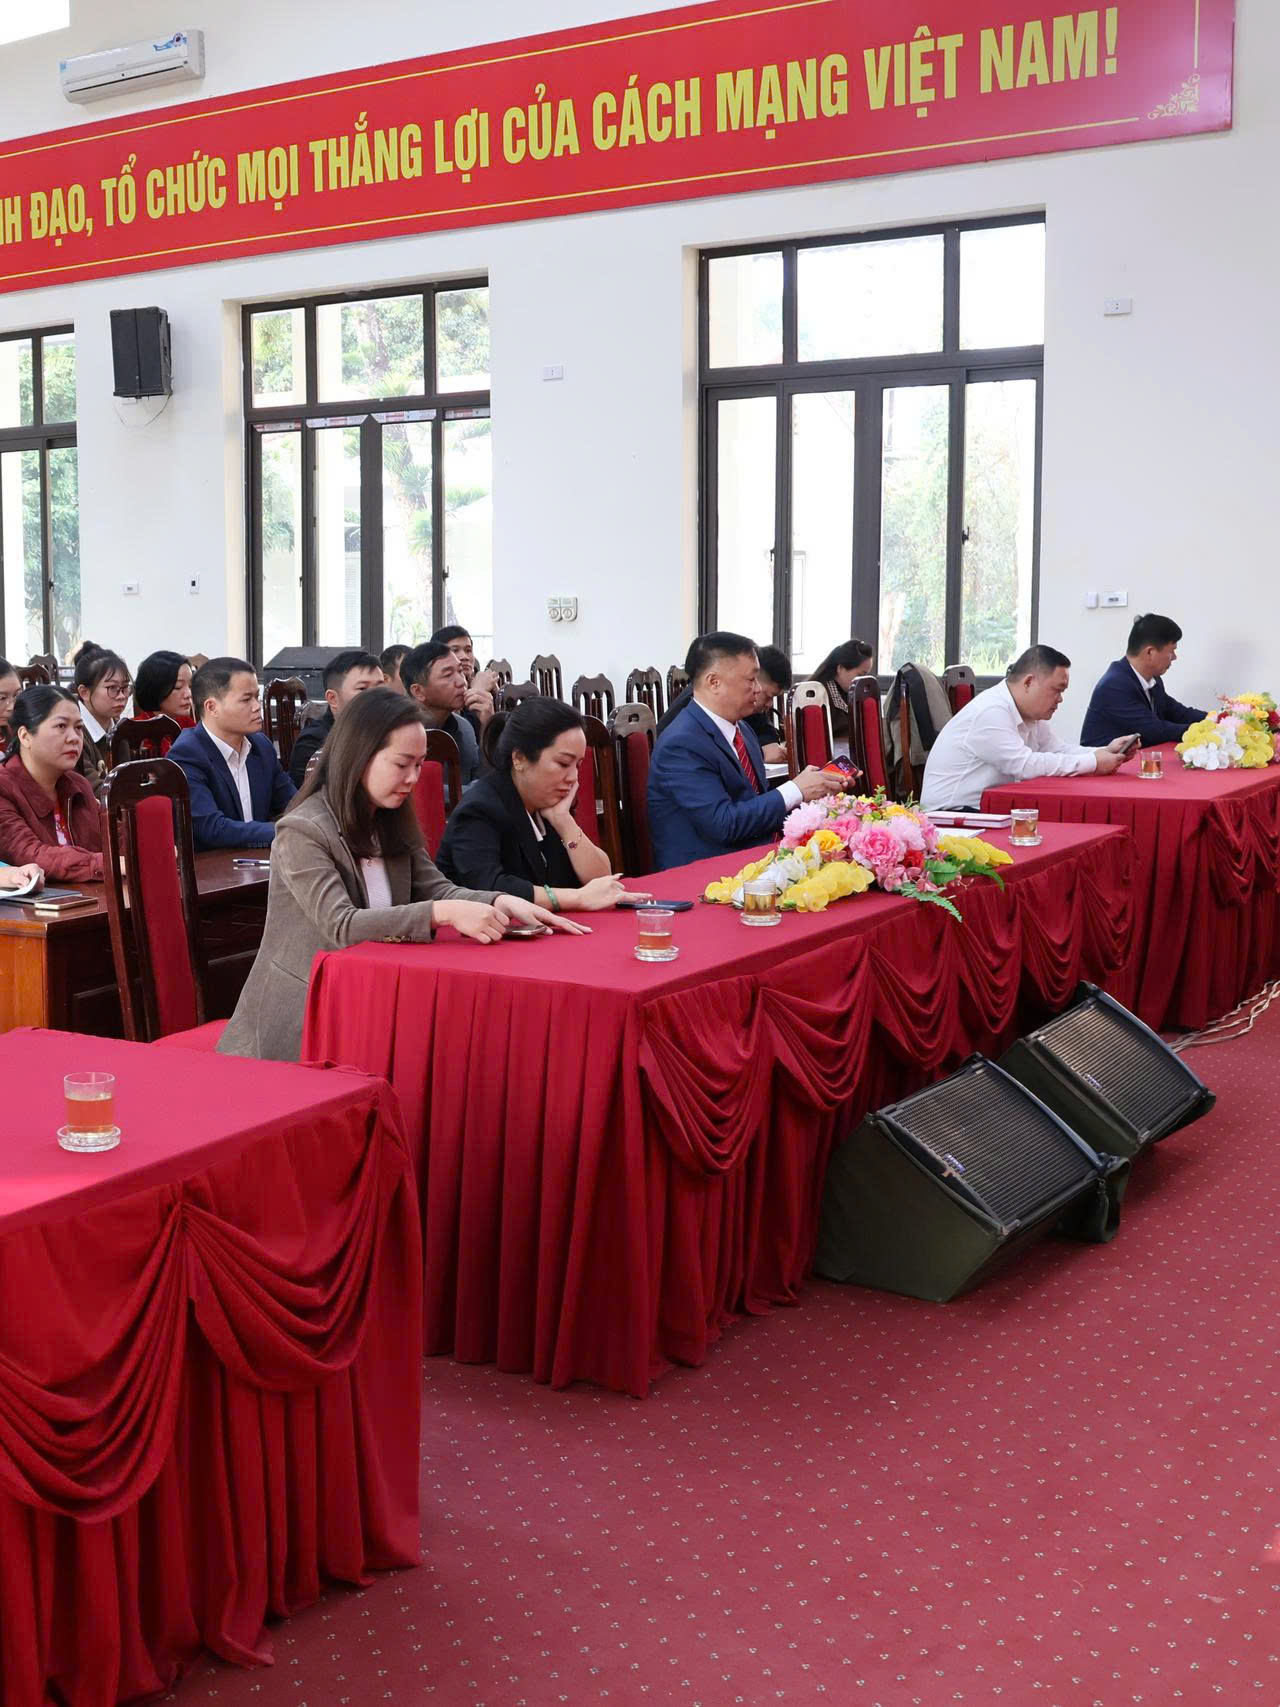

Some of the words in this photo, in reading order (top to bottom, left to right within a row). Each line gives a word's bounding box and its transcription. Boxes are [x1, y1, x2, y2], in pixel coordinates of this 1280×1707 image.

[30, 184, 93, 246] ĐẠO,
[101, 154, 137, 224] TỔ
[147, 151, 226, 218] CHỨC
[238, 145, 299, 210] MỌI
[309, 112, 422, 192] THẮNG
[435, 108, 490, 183] LỢI
[503, 84, 579, 163] CỦA
[593, 75, 700, 150] CÁCH
[717, 54, 848, 140] MẠNG
[864, 26, 963, 118] VIỆT
[981, 7, 1118, 93] NAM!
